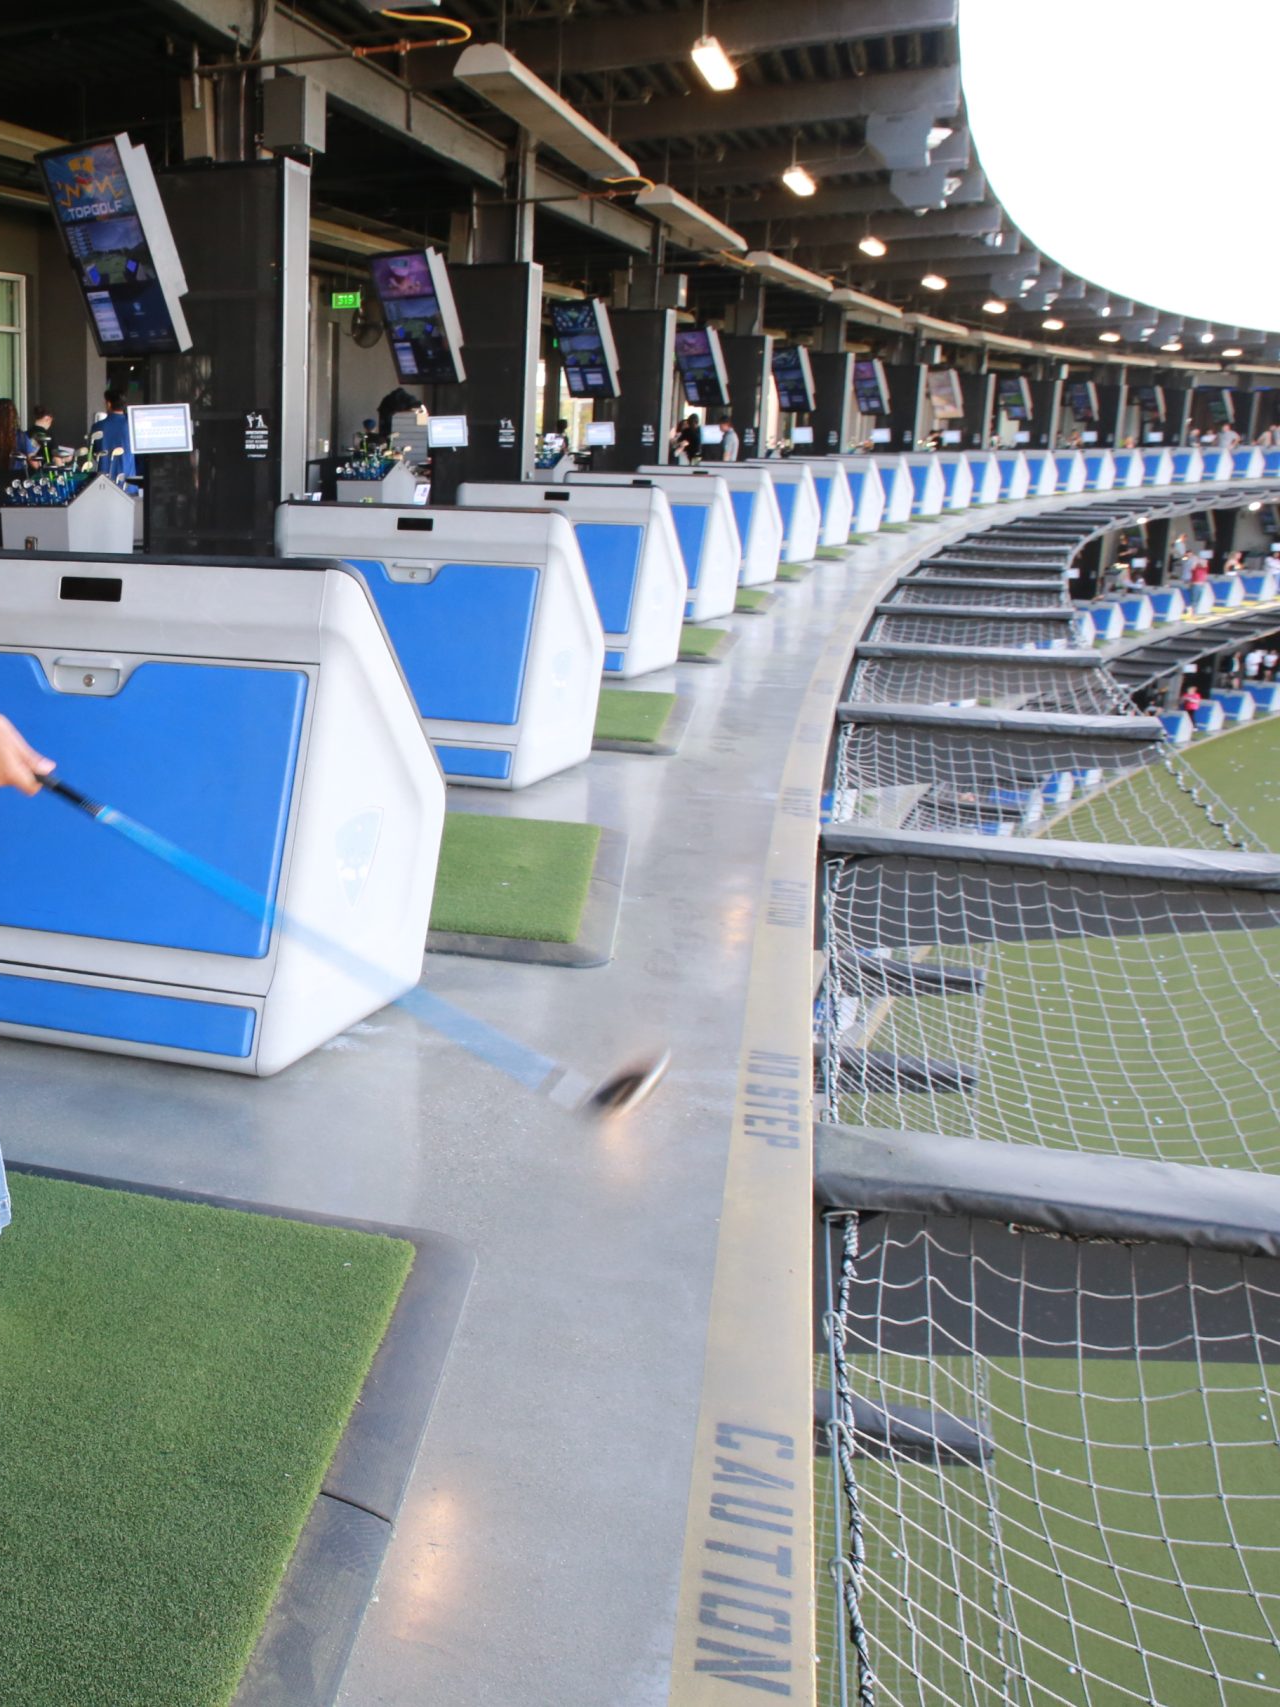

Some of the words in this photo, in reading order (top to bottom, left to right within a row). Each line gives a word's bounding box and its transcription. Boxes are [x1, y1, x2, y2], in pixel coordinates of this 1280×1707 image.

[67, 200, 123, 220] TOPGOLF
[747, 1050, 800, 1078] NO
[743, 1083, 800, 1150] STEP
[694, 1421, 795, 1697] CAUTION
